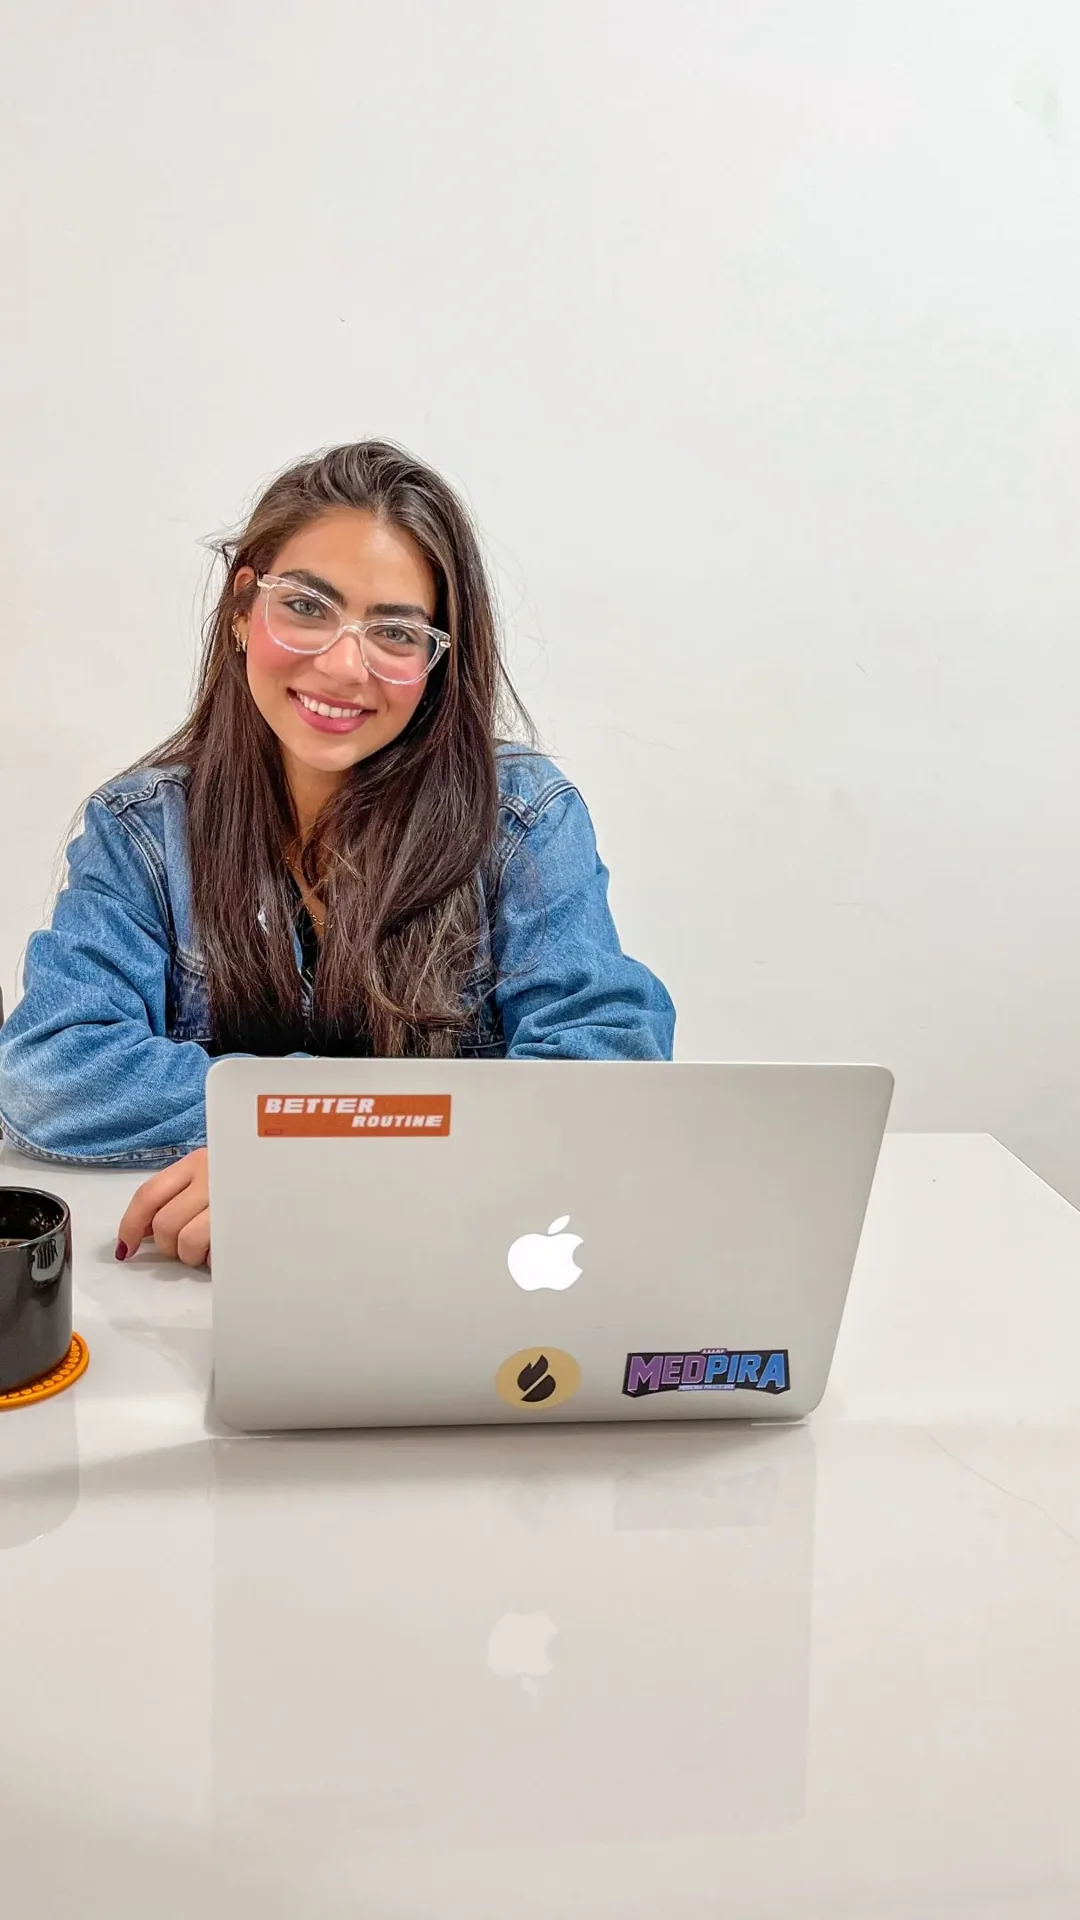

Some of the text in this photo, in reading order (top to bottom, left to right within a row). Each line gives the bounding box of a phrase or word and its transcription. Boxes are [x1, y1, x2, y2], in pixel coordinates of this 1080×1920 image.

[264, 1097, 375, 1114] BETTER
[351, 1115, 444, 1128] ROUTINE
[626, 1353, 786, 1393] MEDPIRA
